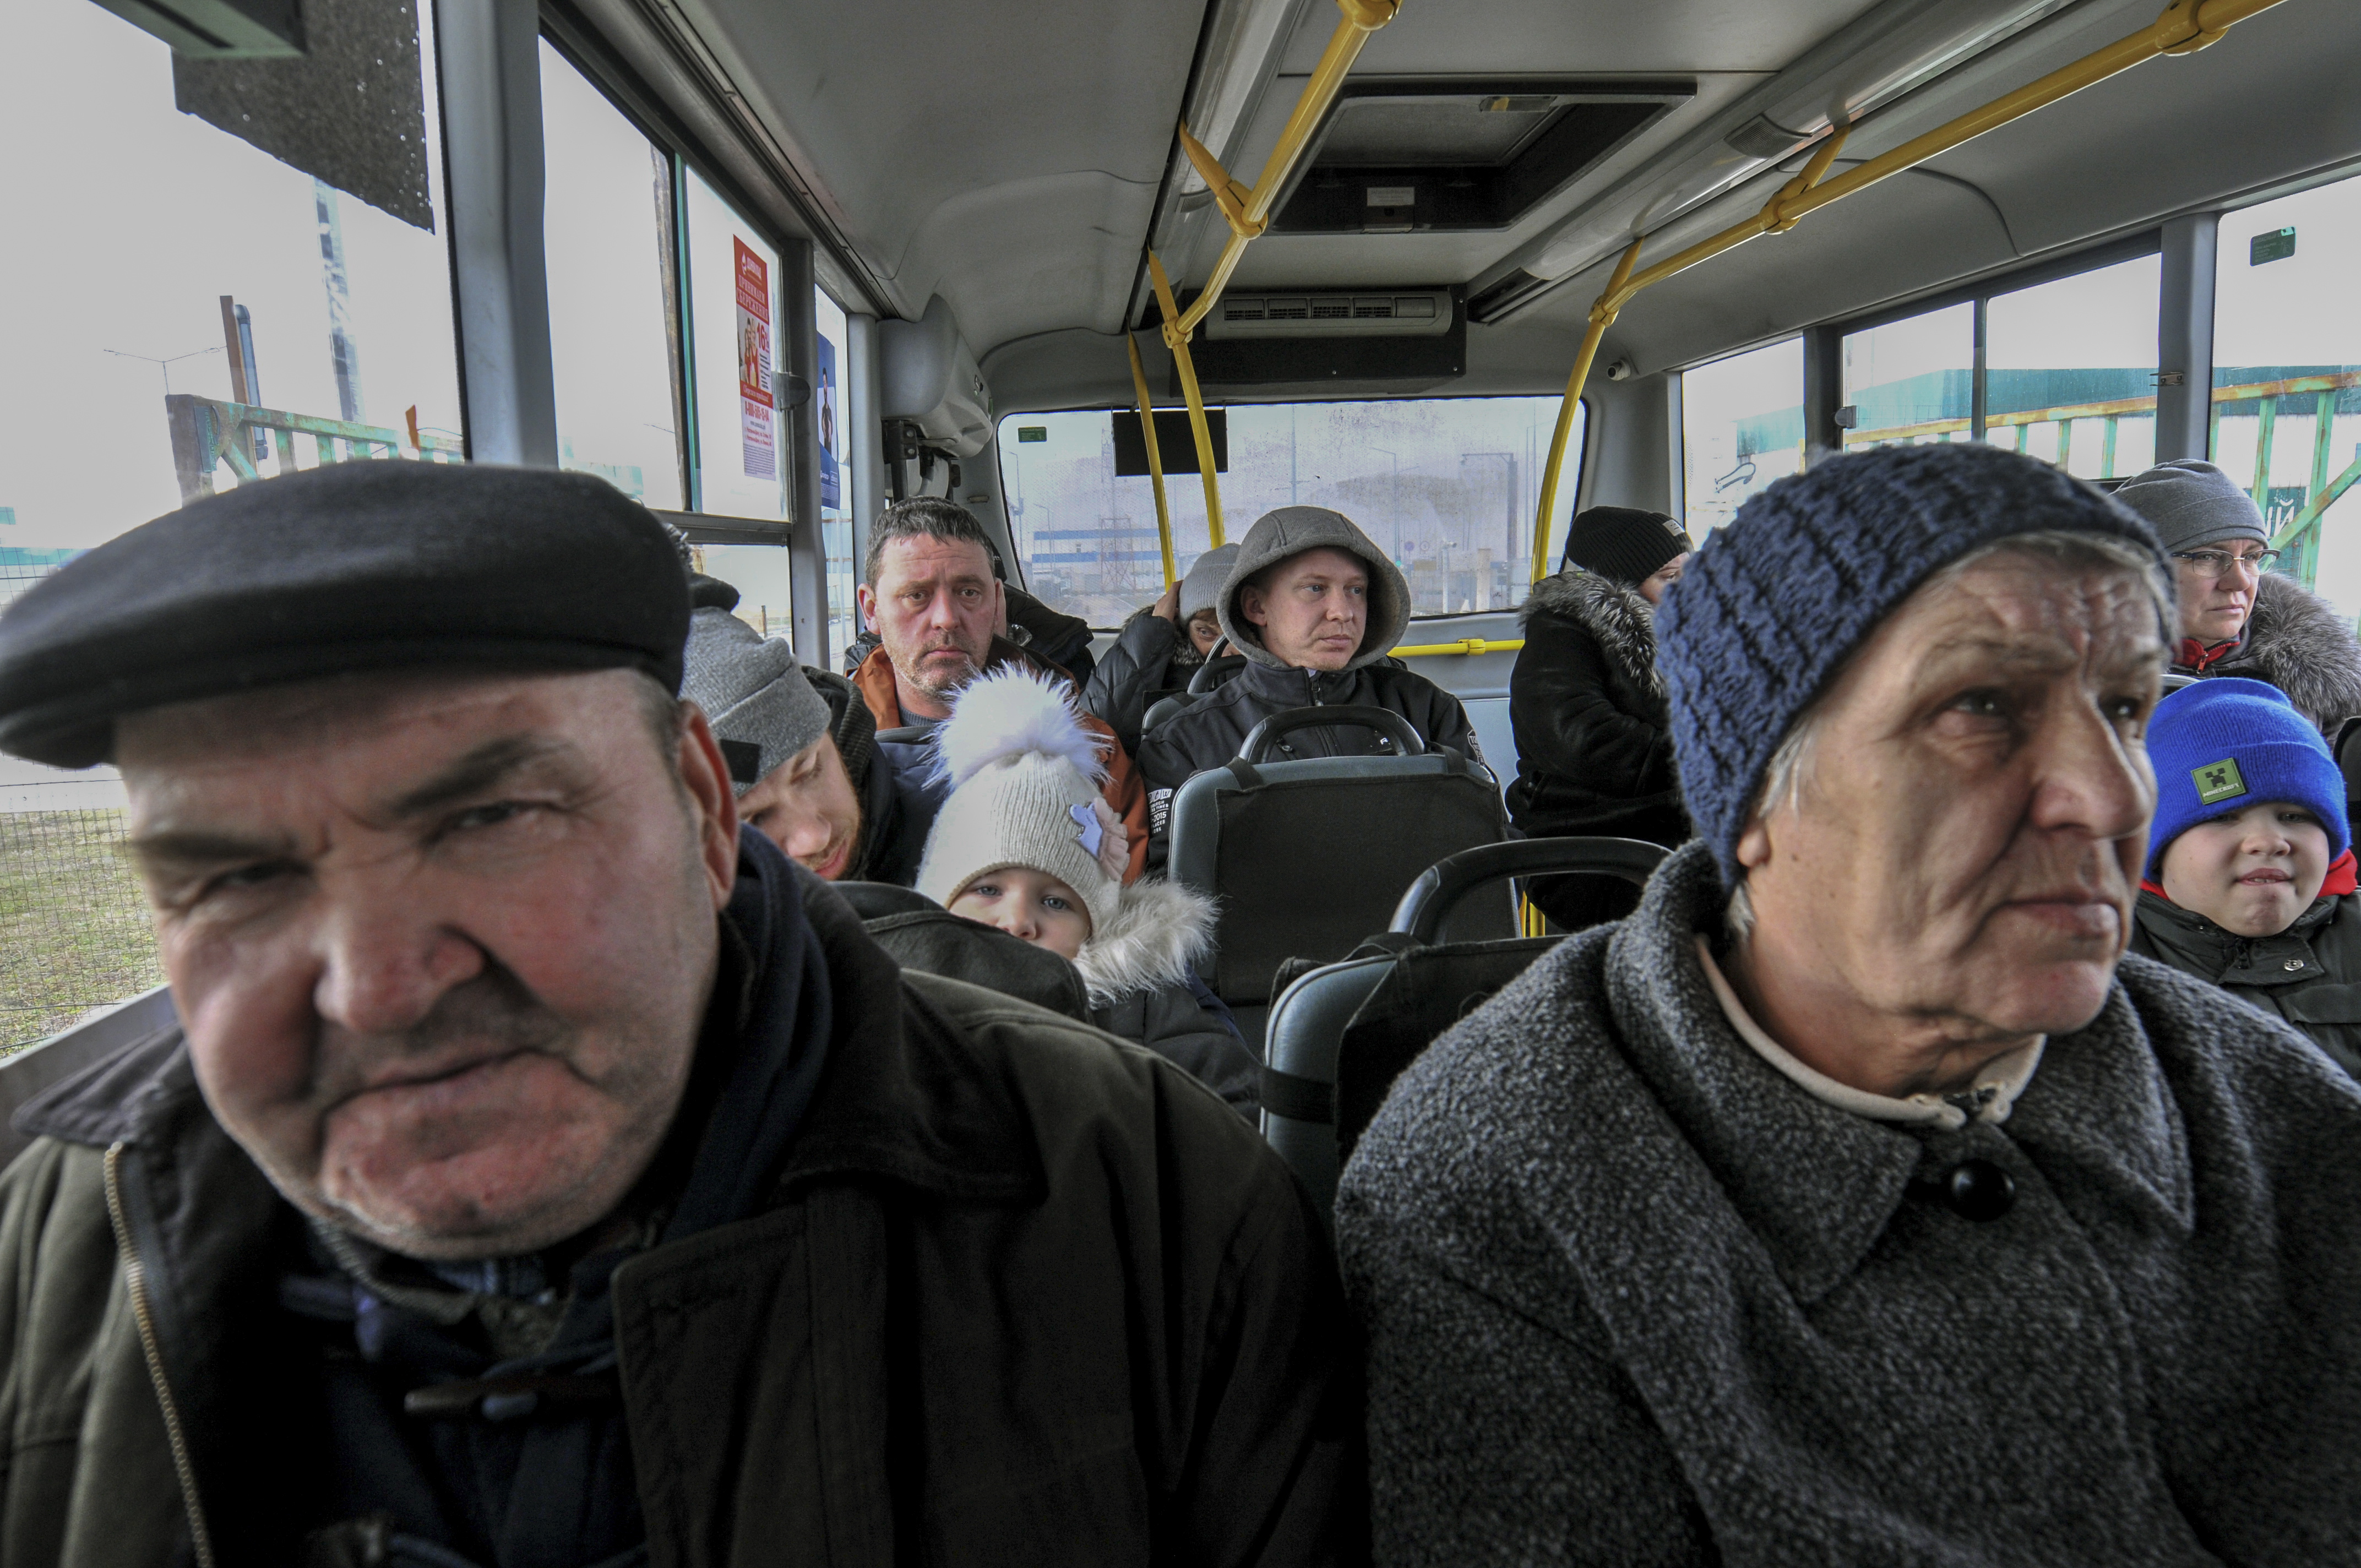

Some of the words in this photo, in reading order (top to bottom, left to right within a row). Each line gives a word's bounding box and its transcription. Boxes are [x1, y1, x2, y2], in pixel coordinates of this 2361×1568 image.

[738, 274, 765, 305] ПРИНИМАЕМ
[736, 287, 768, 321] СБЕРЕЖЕНИЯ
[2202, 783, 2239, 797] MINECRAFT
[1151, 811, 1167, 823] -2015
